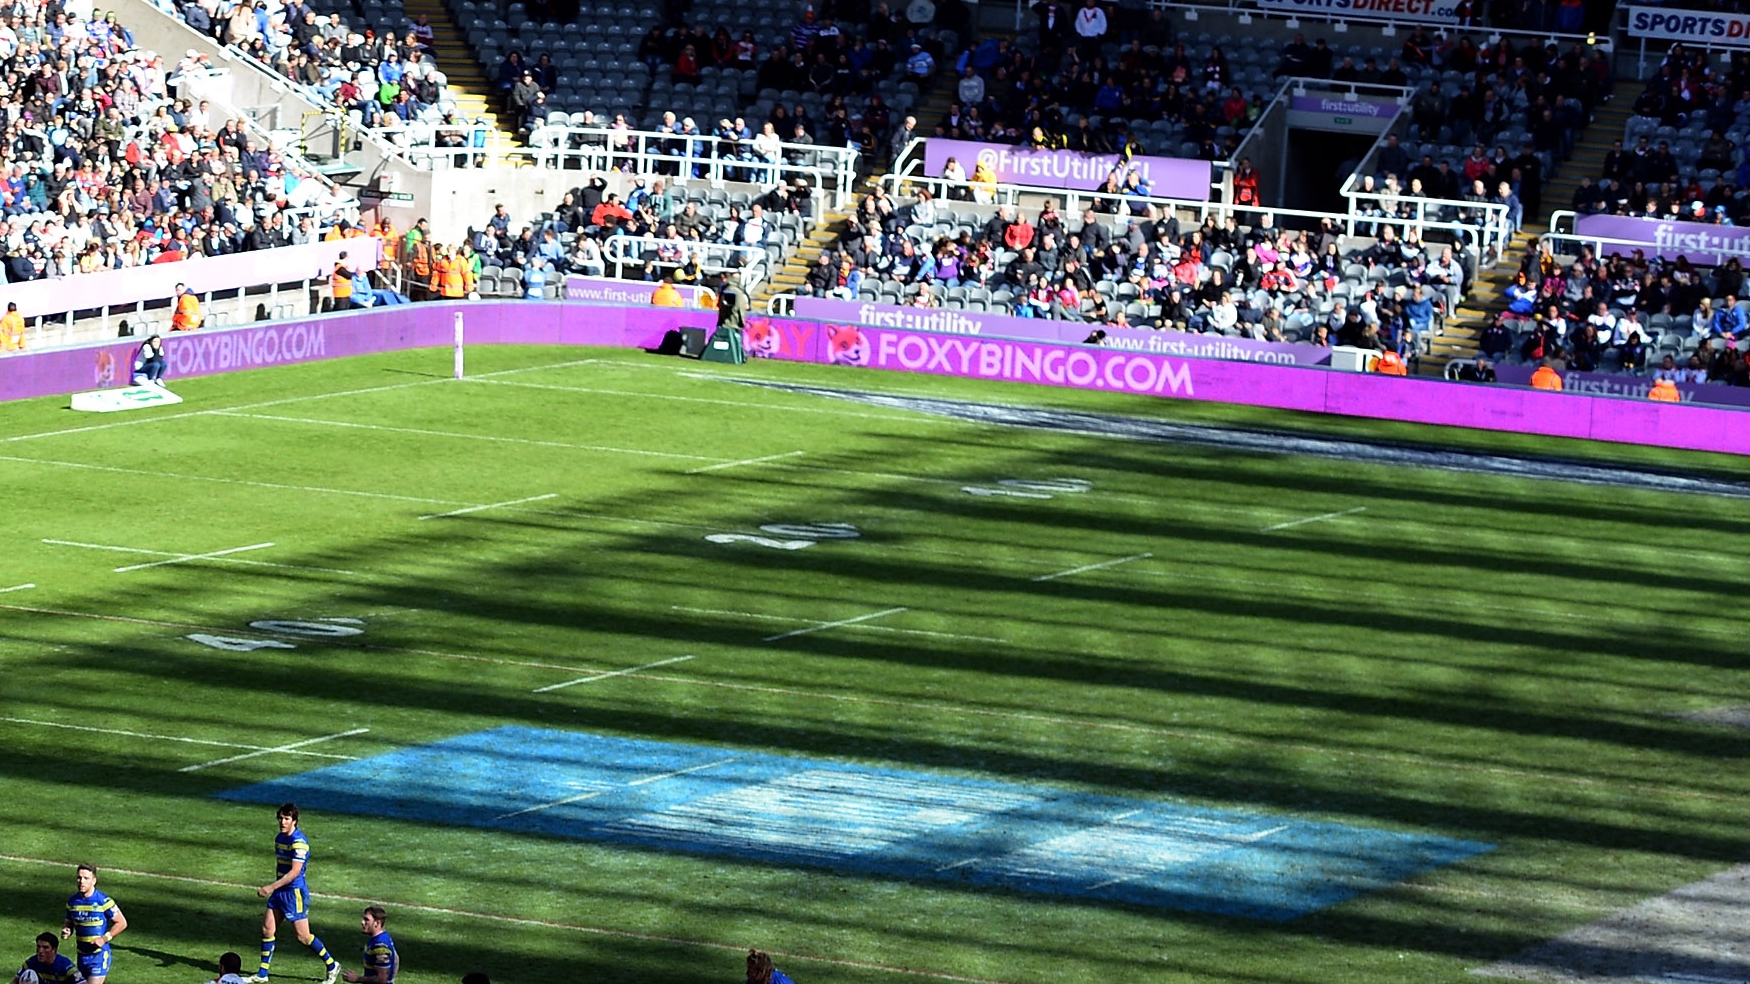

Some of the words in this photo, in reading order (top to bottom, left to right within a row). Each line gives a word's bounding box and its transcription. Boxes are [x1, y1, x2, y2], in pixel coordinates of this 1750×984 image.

[859, 308, 982, 335] first:utility
[167, 324, 325, 376] FOXYBINGO.COM
[878, 333, 1194, 396] FOXYBINGO.COM
